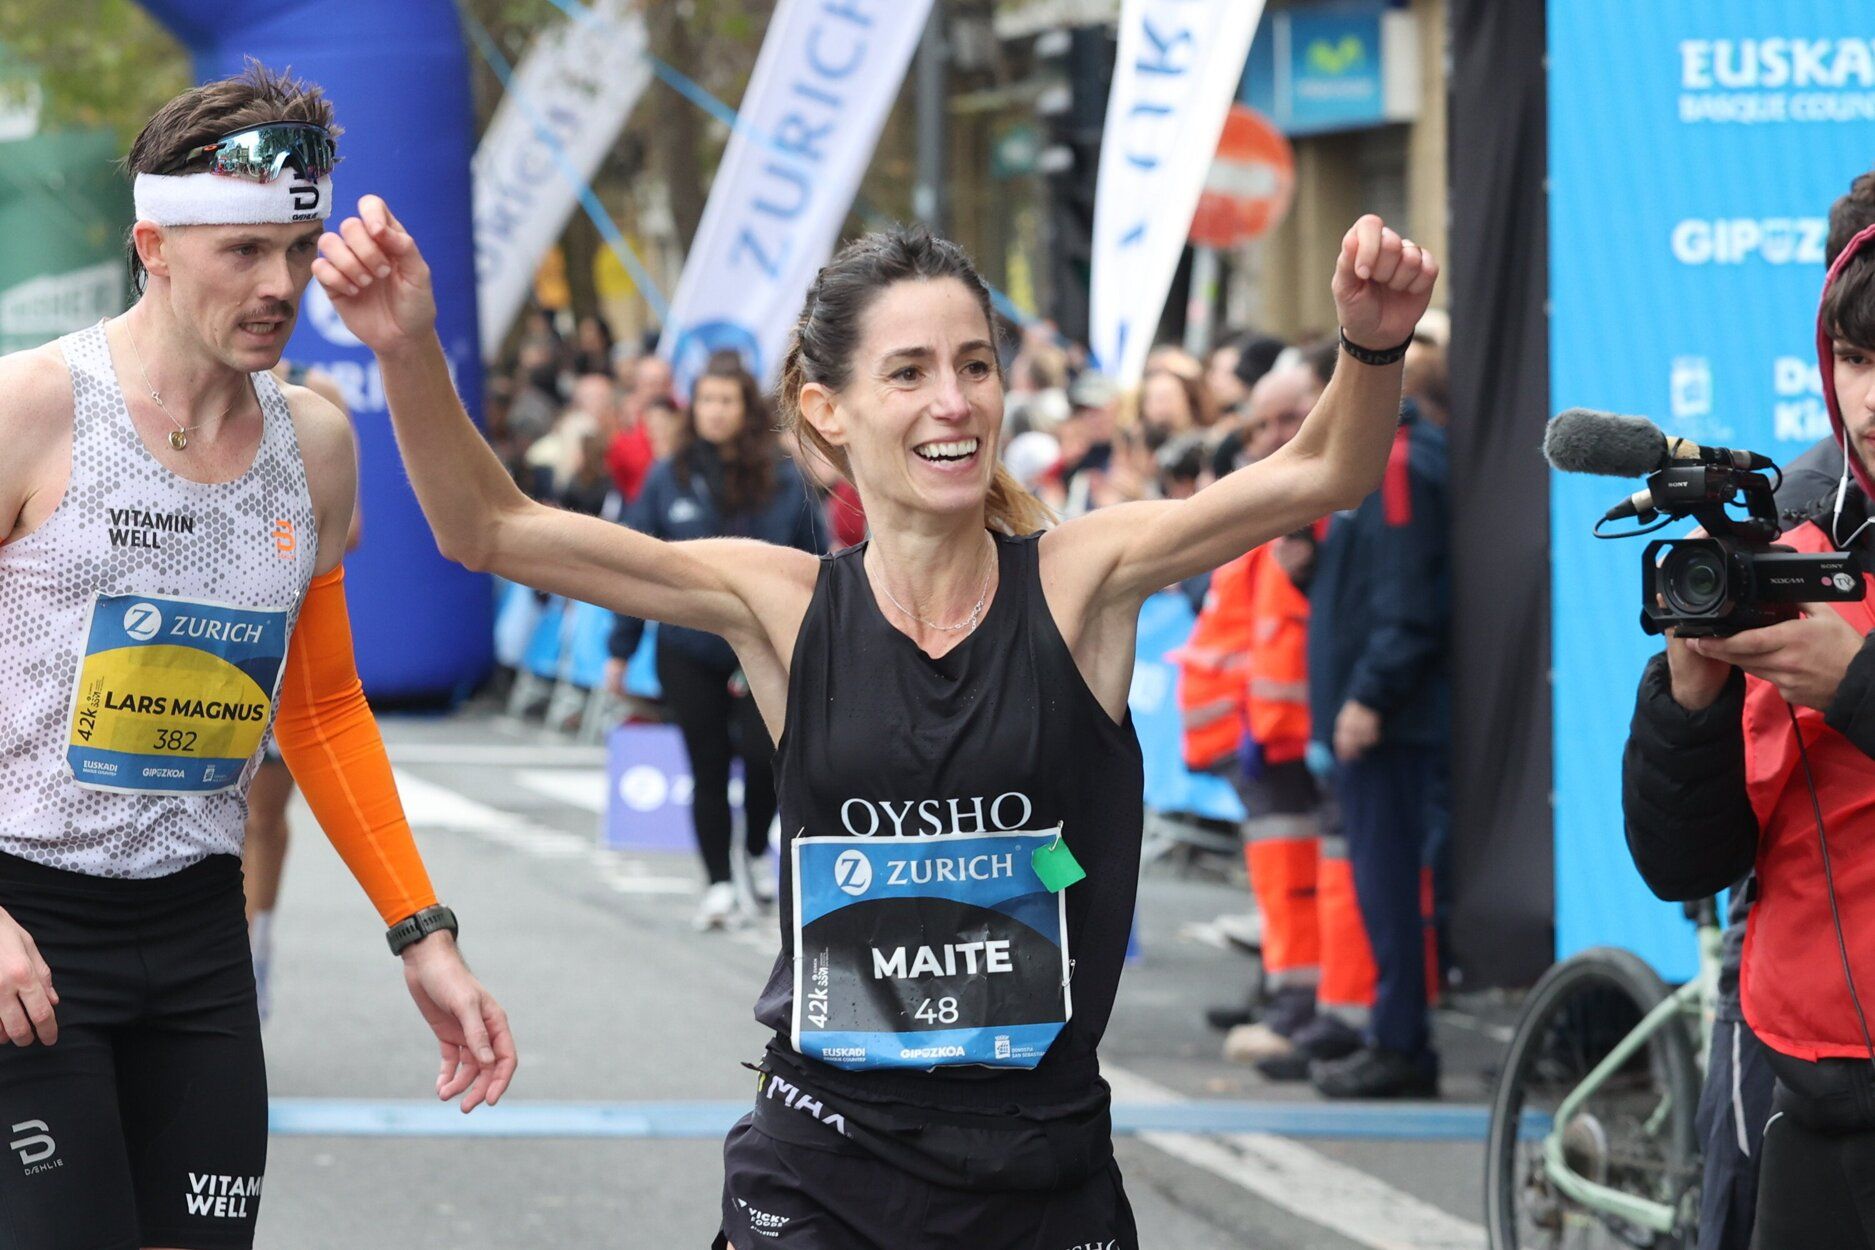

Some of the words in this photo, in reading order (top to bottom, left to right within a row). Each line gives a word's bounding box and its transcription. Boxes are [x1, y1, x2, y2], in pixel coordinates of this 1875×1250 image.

[1680, 37, 1875, 89] EUSKA
[729, 0, 872, 278] ZURIC
[109, 508, 194, 534] VITAMIN
[108, 528, 161, 549] WELL
[170, 615, 264, 643] ZURICH
[104, 691, 167, 715] LARS
[171, 698, 265, 722] MAGNUS
[77, 707, 98, 742] 42k
[153, 728, 198, 752] 382
[83, 760, 118, 773] EUSKADI
[840, 791, 1032, 837] OYSHO
[887, 853, 1013, 885] ZURICH
[871, 939, 1013, 980] MAITE
[807, 987, 828, 1029] 42k
[914, 996, 959, 1025] 48
[822, 1047, 866, 1057] EUSKADI
[185, 1192, 248, 1218] WELL
[748, 1207, 790, 1223] VICKY
